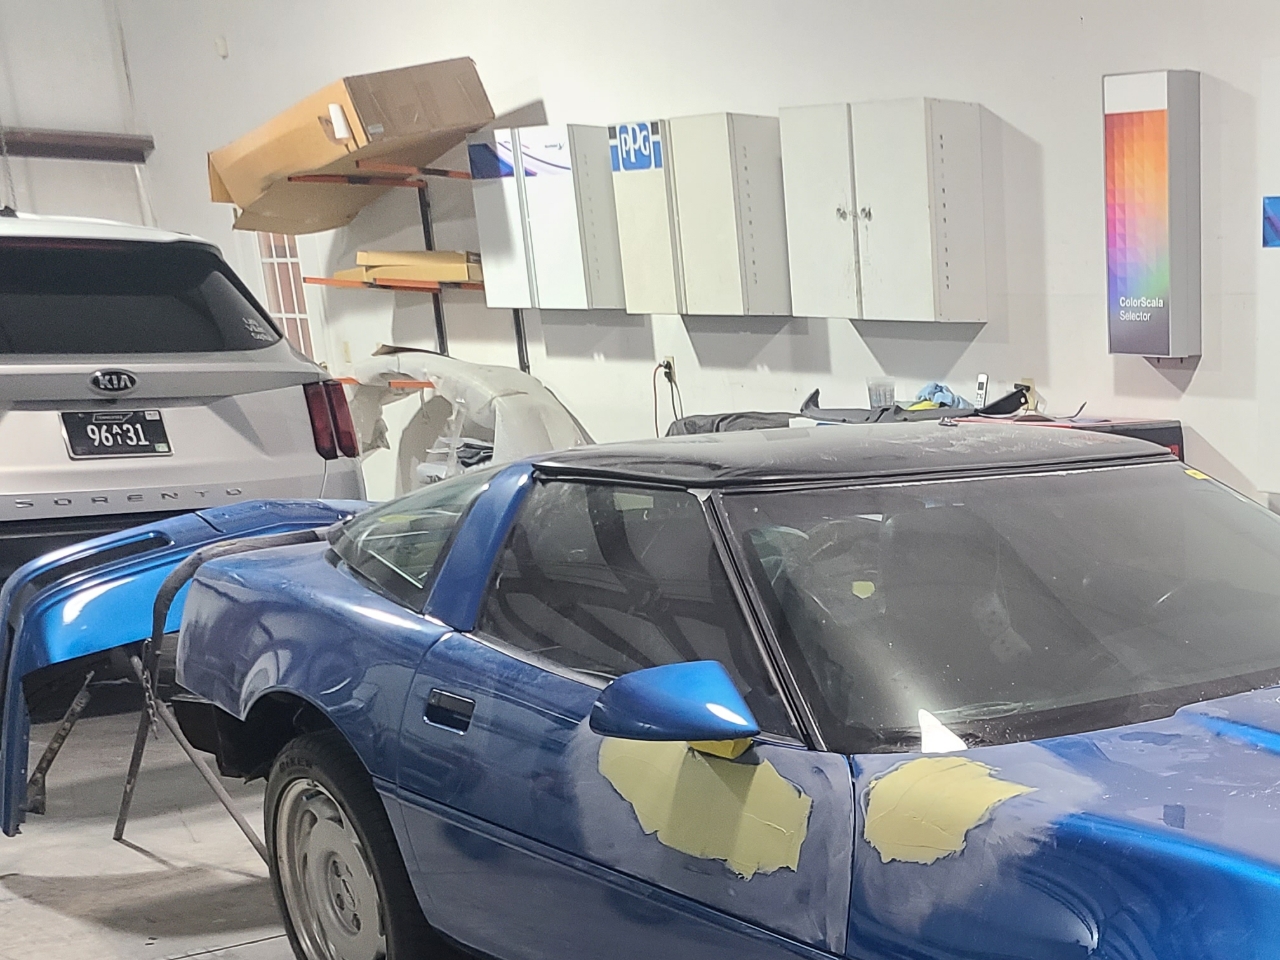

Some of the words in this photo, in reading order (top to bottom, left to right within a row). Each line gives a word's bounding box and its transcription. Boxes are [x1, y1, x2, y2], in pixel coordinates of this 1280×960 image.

[620, 123, 650, 163] PPG
[1119, 297, 1164, 308] ColorScala
[1120, 310, 1151, 321] Selector
[99, 374, 132, 389] KIA
[14, 487, 242, 508] SORENTO
